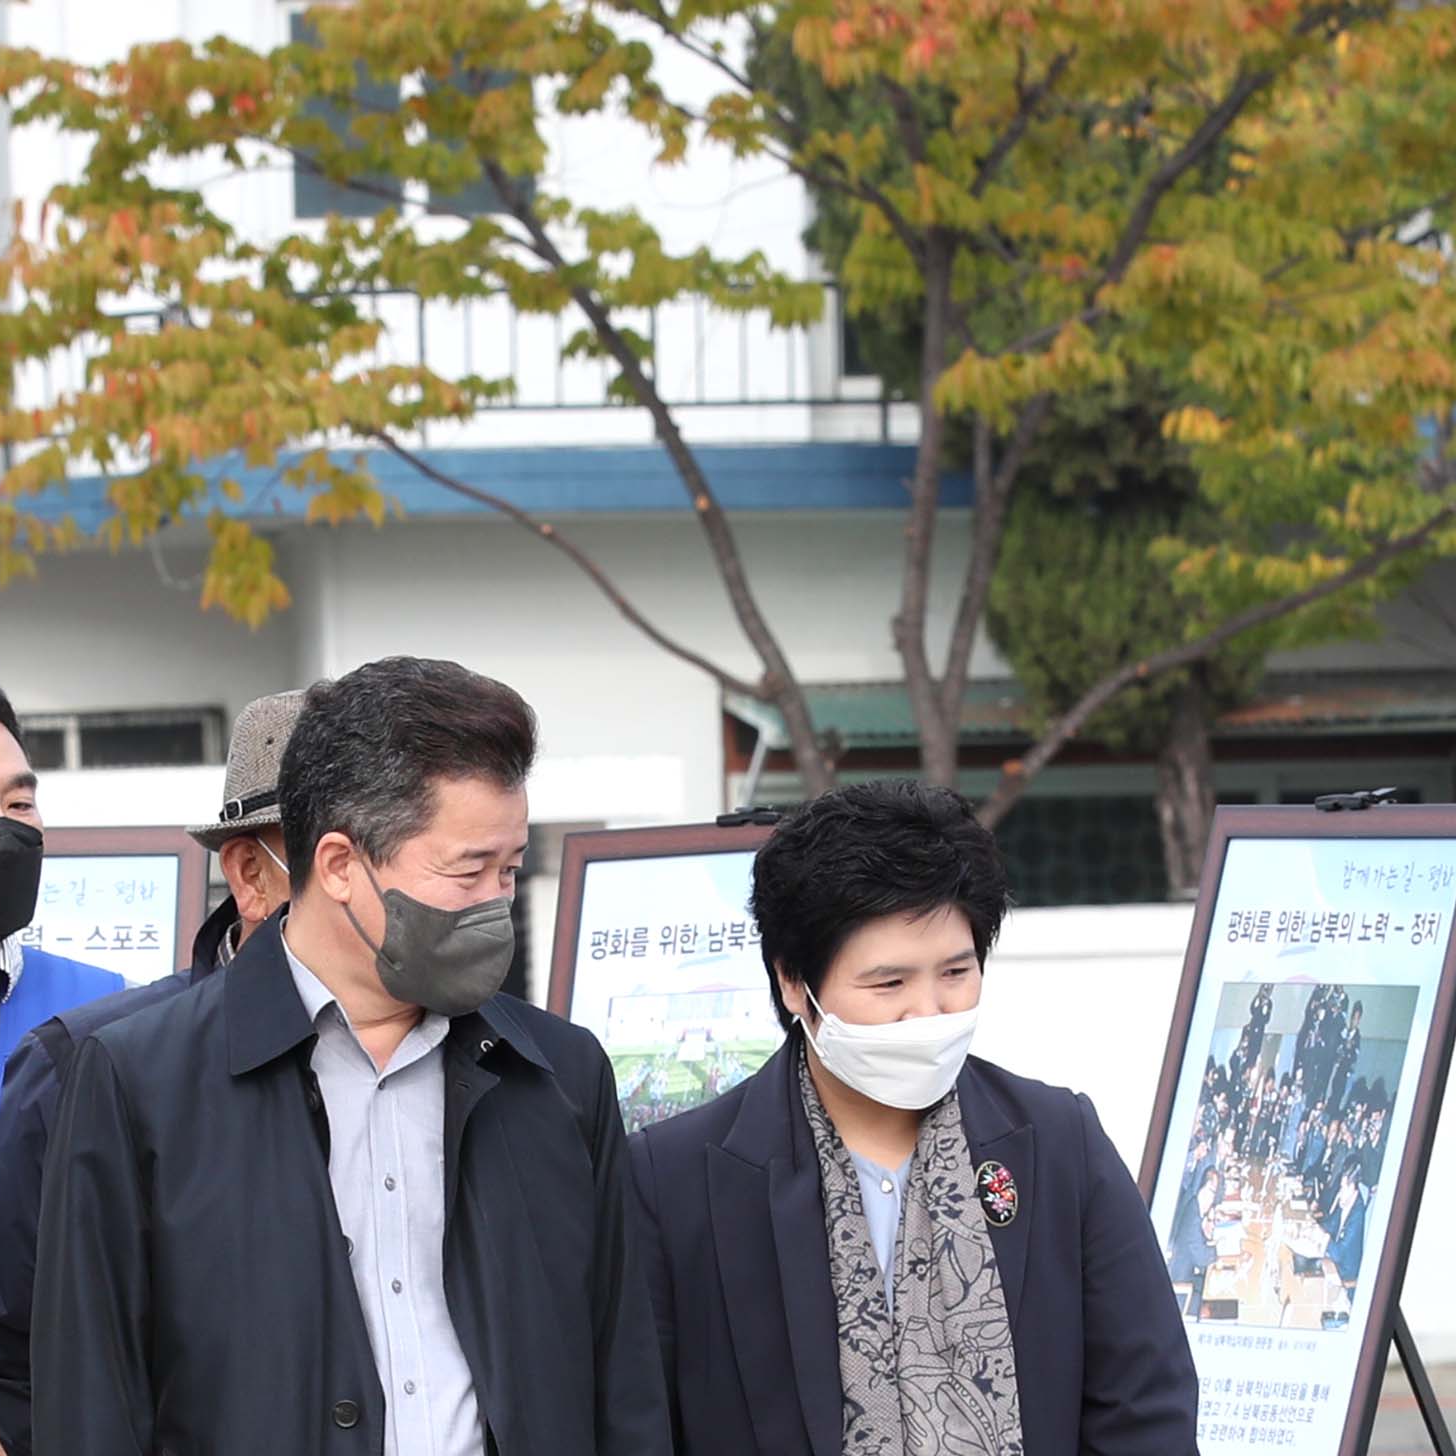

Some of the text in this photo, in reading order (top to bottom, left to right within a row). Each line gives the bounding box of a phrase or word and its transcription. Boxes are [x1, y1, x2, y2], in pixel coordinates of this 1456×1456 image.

[21, 925, 43, 951] 력
[84, 924, 161, 950] 스포츠
[590, 926, 649, 961] 평화를
[659, 924, 699, 956] 위한
[1227, 910, 1272, 943] 평화를
[1276, 911, 1307, 943] 위한
[1310, 911, 1356, 944] 남북의
[1357, 912, 1390, 945] 노력
[1410, 912, 1442, 945] 정치
